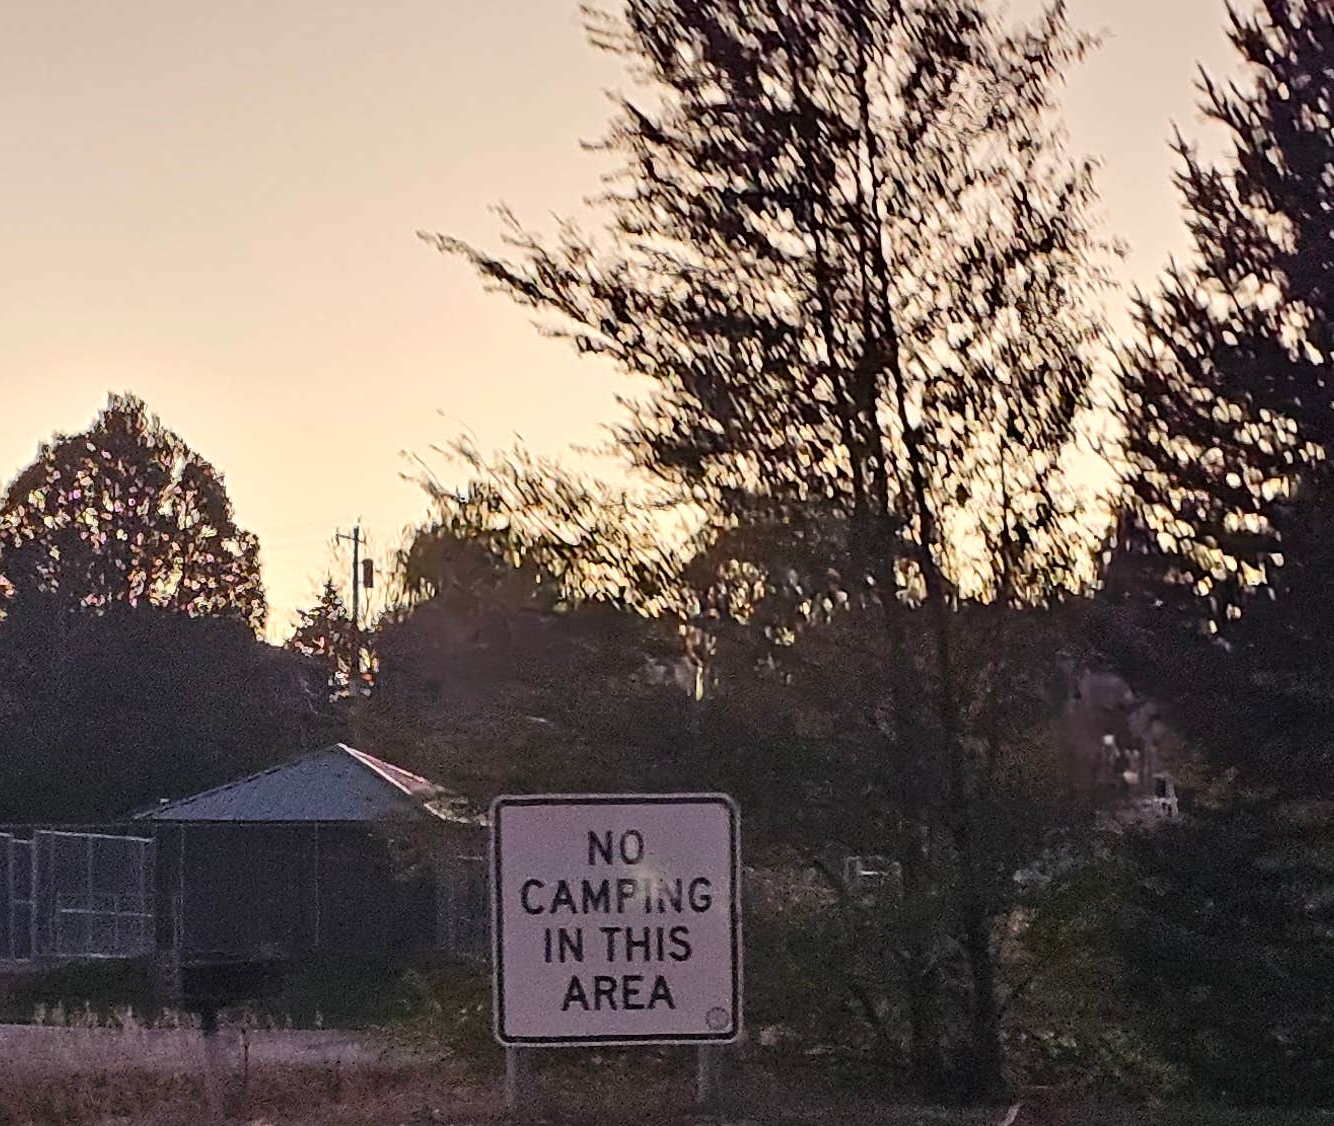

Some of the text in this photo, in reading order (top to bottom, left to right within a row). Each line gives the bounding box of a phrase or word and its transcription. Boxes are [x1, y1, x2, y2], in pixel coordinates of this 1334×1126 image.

[587, 829, 644, 866] NO
[520, 877, 712, 914] CAMPING
[544, 925, 692, 963] IN THIS
[561, 975, 675, 1011] AREA
